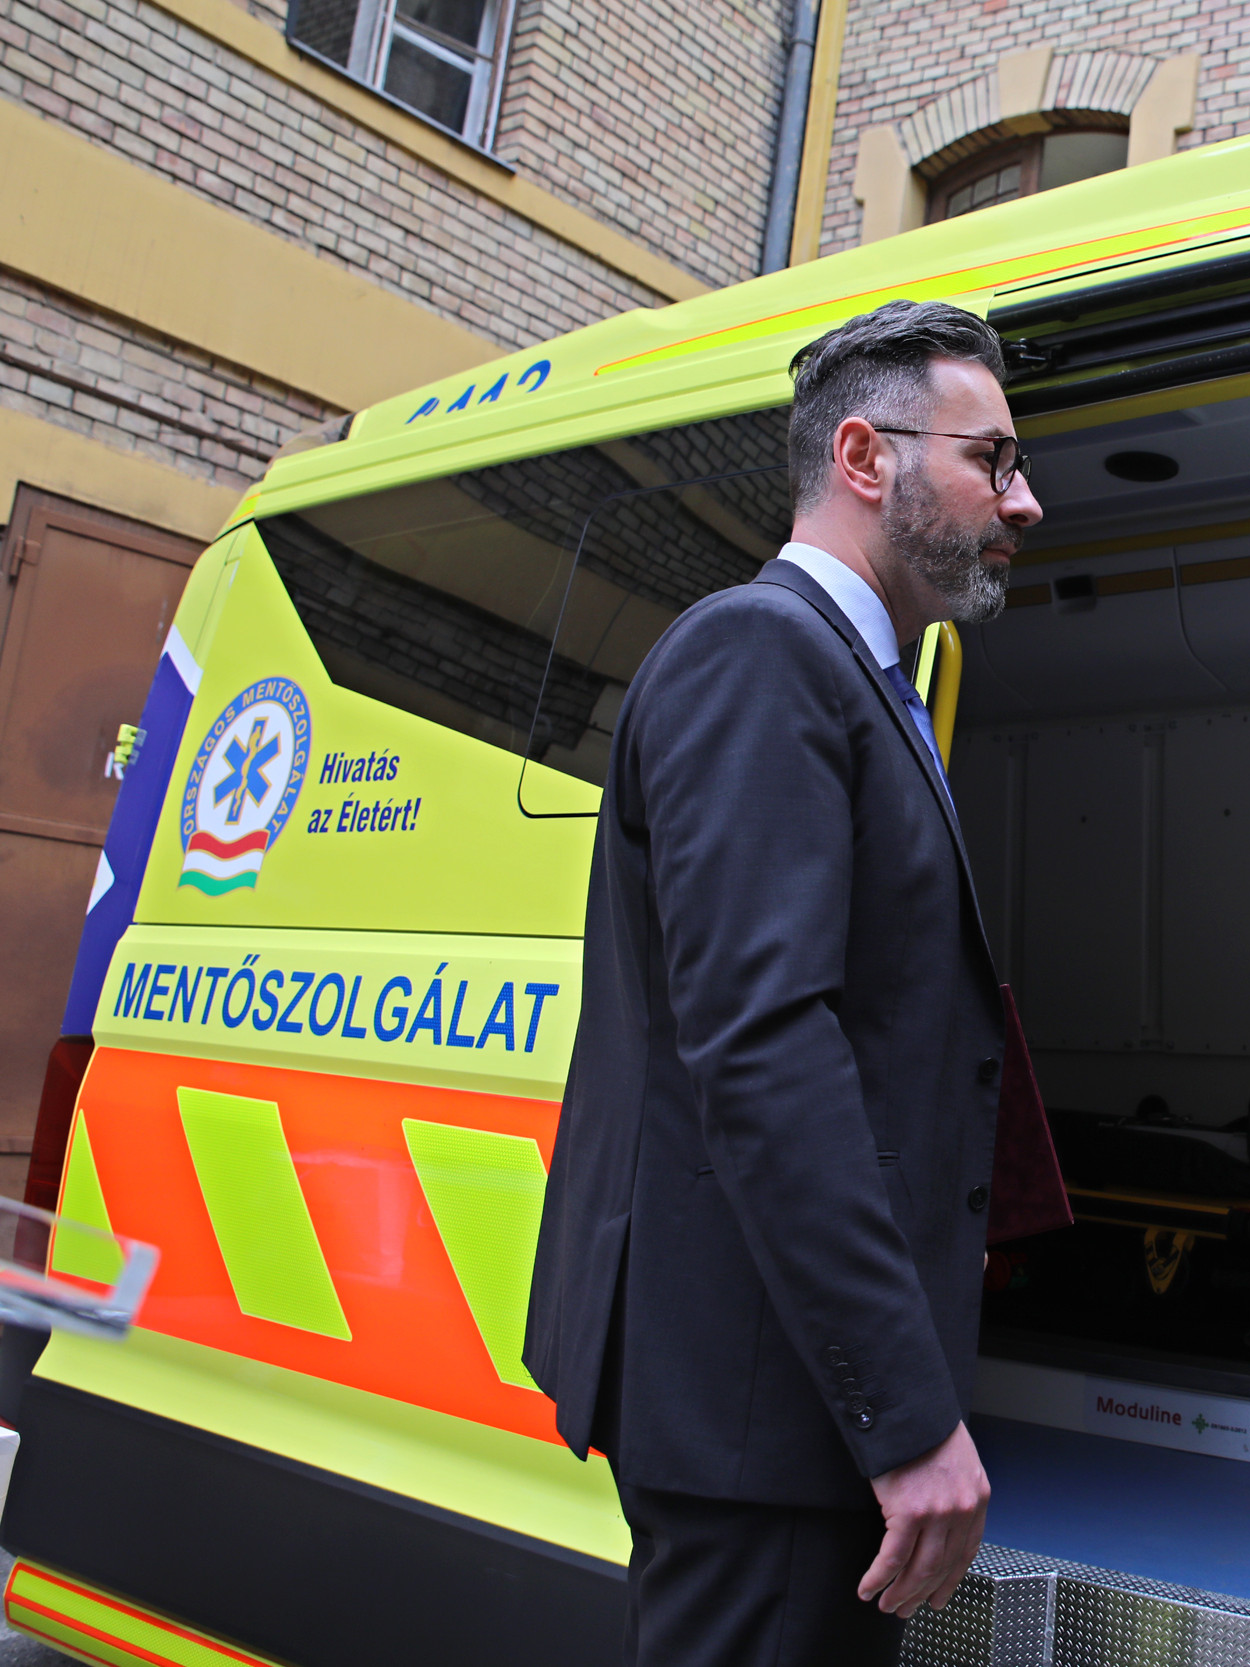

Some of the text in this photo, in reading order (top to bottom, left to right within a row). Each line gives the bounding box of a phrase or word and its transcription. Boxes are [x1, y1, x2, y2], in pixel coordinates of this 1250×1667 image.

[183, 681, 308, 836] ORSZÁGOS MENTŐSZOLGÁLAT
[318, 748, 401, 785] Hivatás
[306, 791, 422, 834] az Életért!
[113, 953, 560, 1054] MENTŐSZOLGÁLAT
[1096, 1396, 1182, 1426] Moduline
